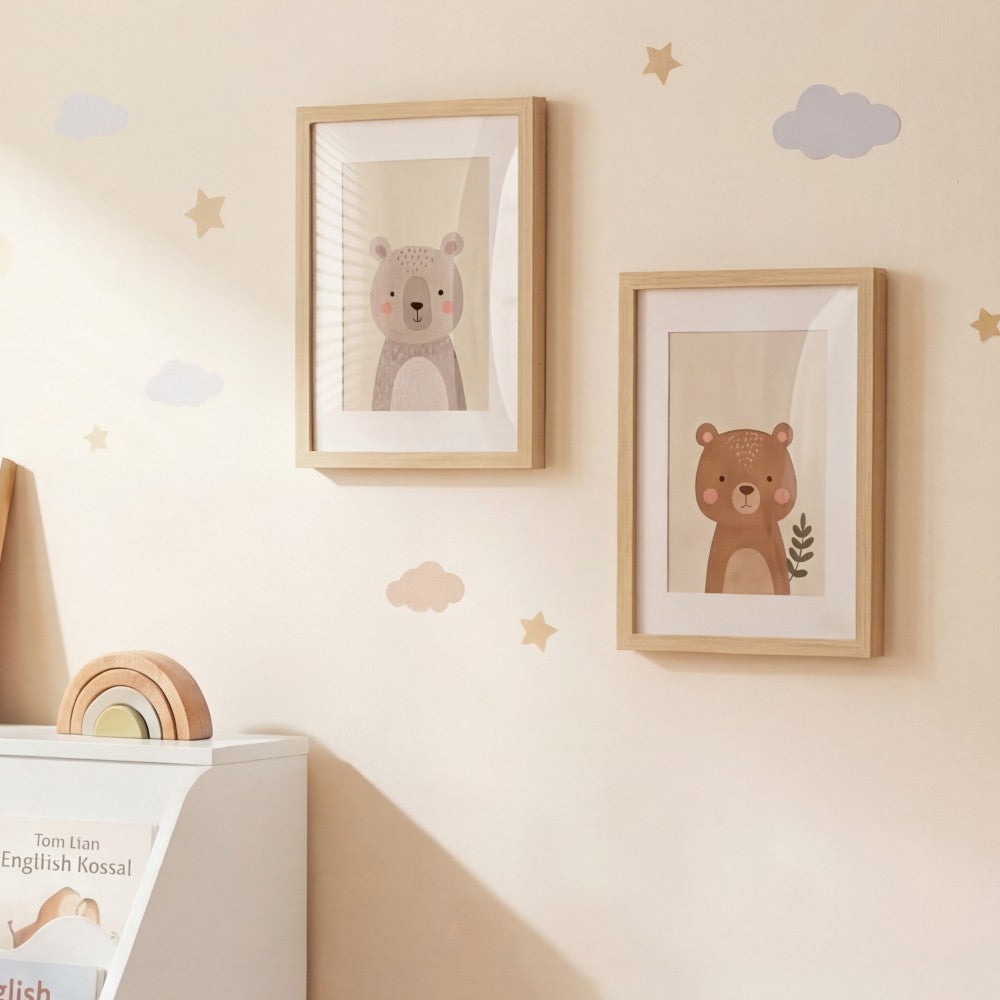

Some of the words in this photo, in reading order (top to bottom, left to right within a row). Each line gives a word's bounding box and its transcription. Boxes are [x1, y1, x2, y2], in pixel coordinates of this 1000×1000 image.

[34, 833, 65, 849] Tom
[70, 836, 100, 851] Lian
[77, 856, 132, 876] Kossal
